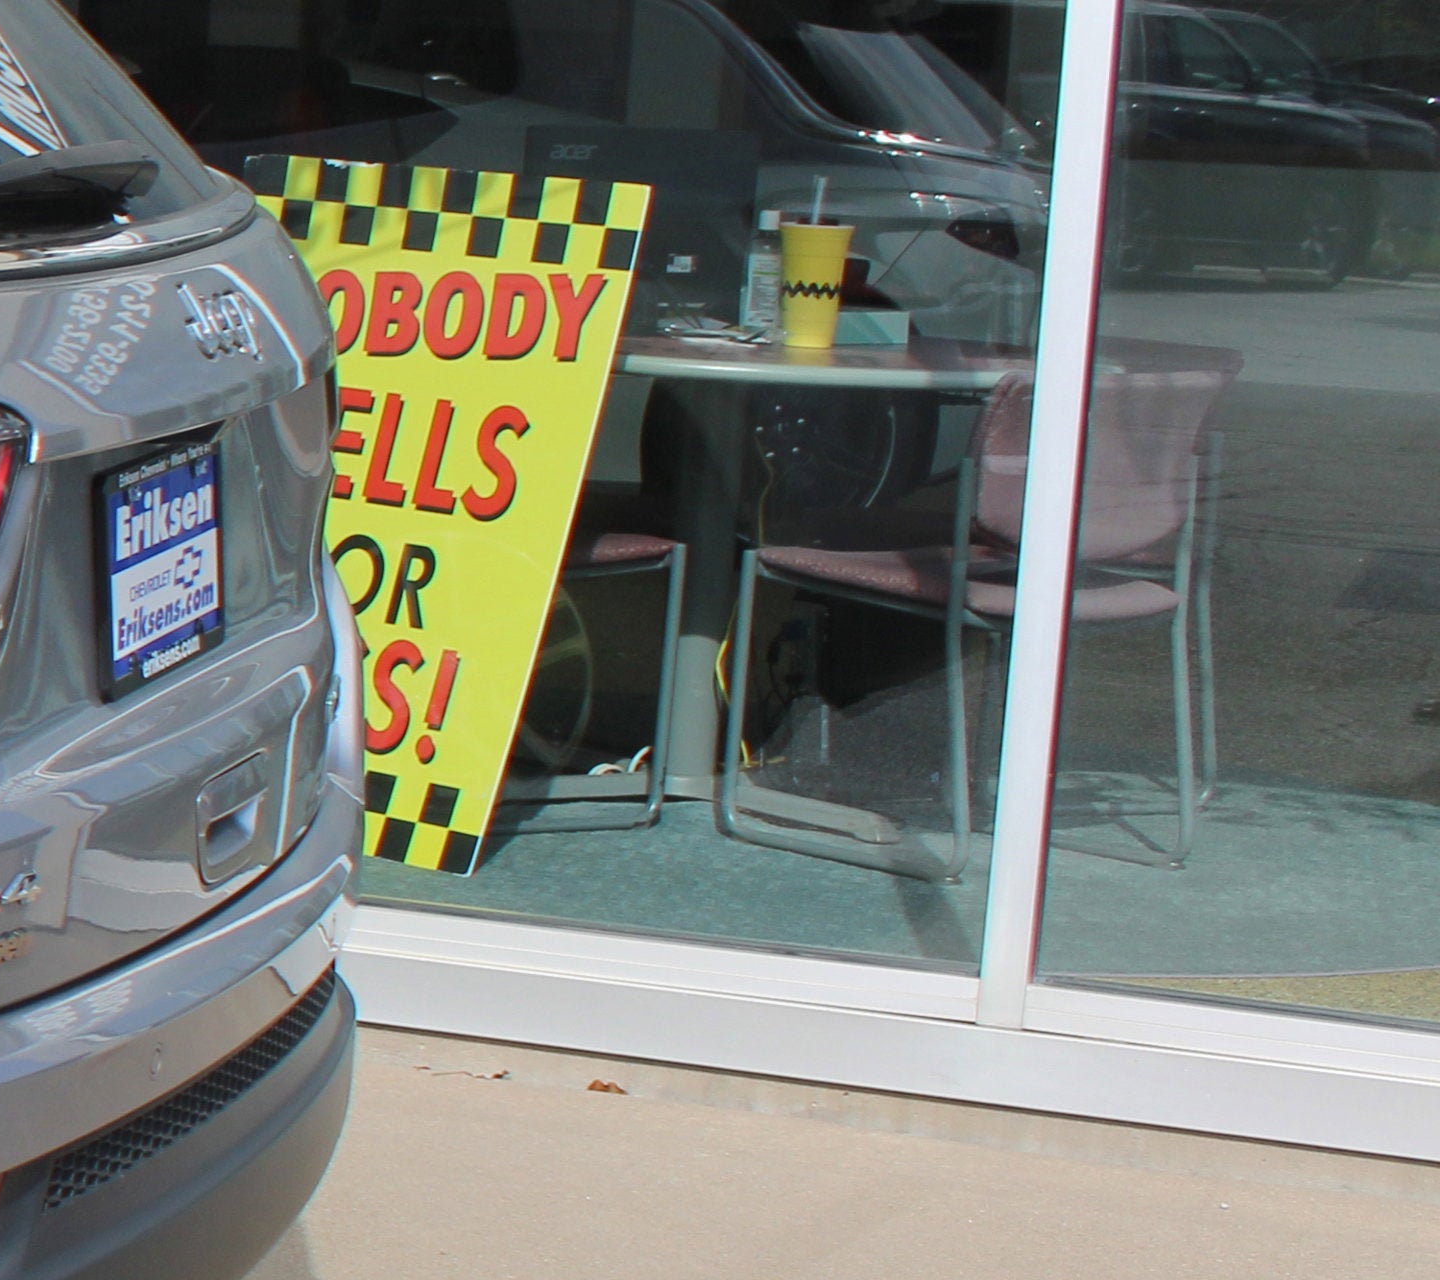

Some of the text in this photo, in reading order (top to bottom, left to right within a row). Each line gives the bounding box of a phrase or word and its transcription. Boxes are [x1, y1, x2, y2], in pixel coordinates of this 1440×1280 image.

[549, 143, 600, 161] acer
[176, 282, 265, 365] Jeep
[316, 269, 608, 363] OBODY
[330, 385, 530, 522] ELLS
[115, 483, 215, 562] Eriksen
[117, 581, 215, 652] Eriksens.com
[130, 569, 172, 603] CHEVROLET
[330, 534, 436, 630] OR
[141, 634, 202, 679] eriksens.com
[360, 636, 460, 765] S!
